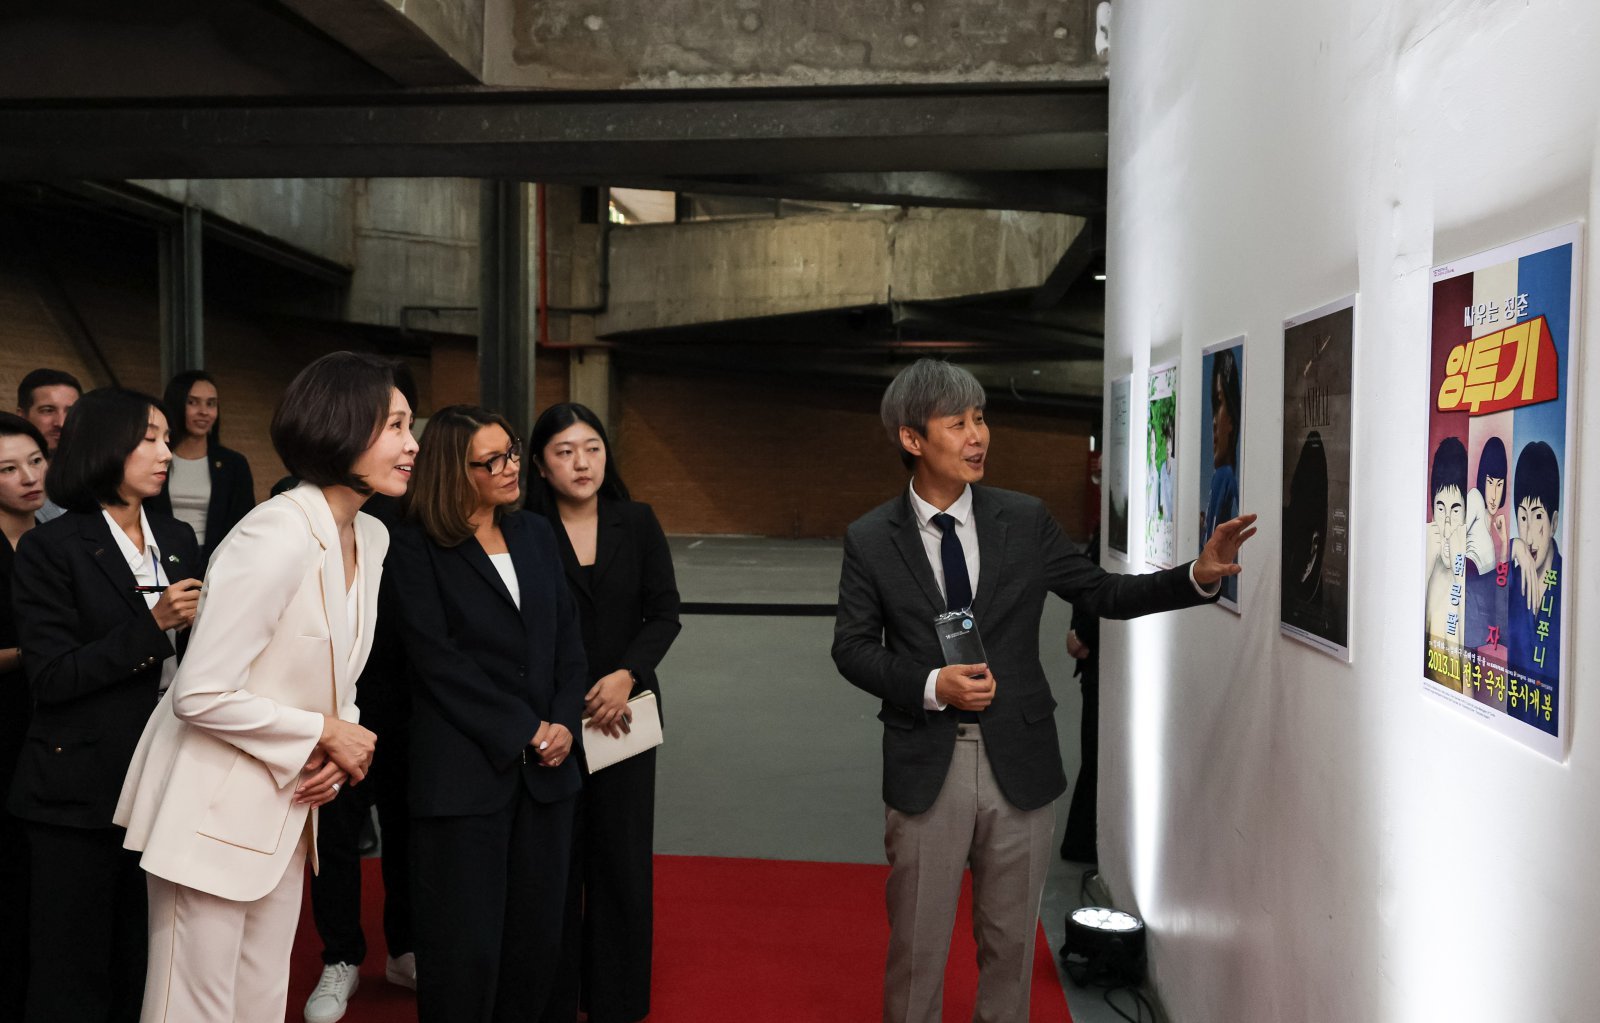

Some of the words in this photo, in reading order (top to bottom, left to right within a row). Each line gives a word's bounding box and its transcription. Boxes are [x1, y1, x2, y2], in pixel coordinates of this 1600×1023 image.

[1438, 317, 1541, 412] 잉투기
[1428, 649, 1461, 681] 2013.11
[1463, 662, 1482, 692] 전국
[1484, 670, 1506, 702] 극장
